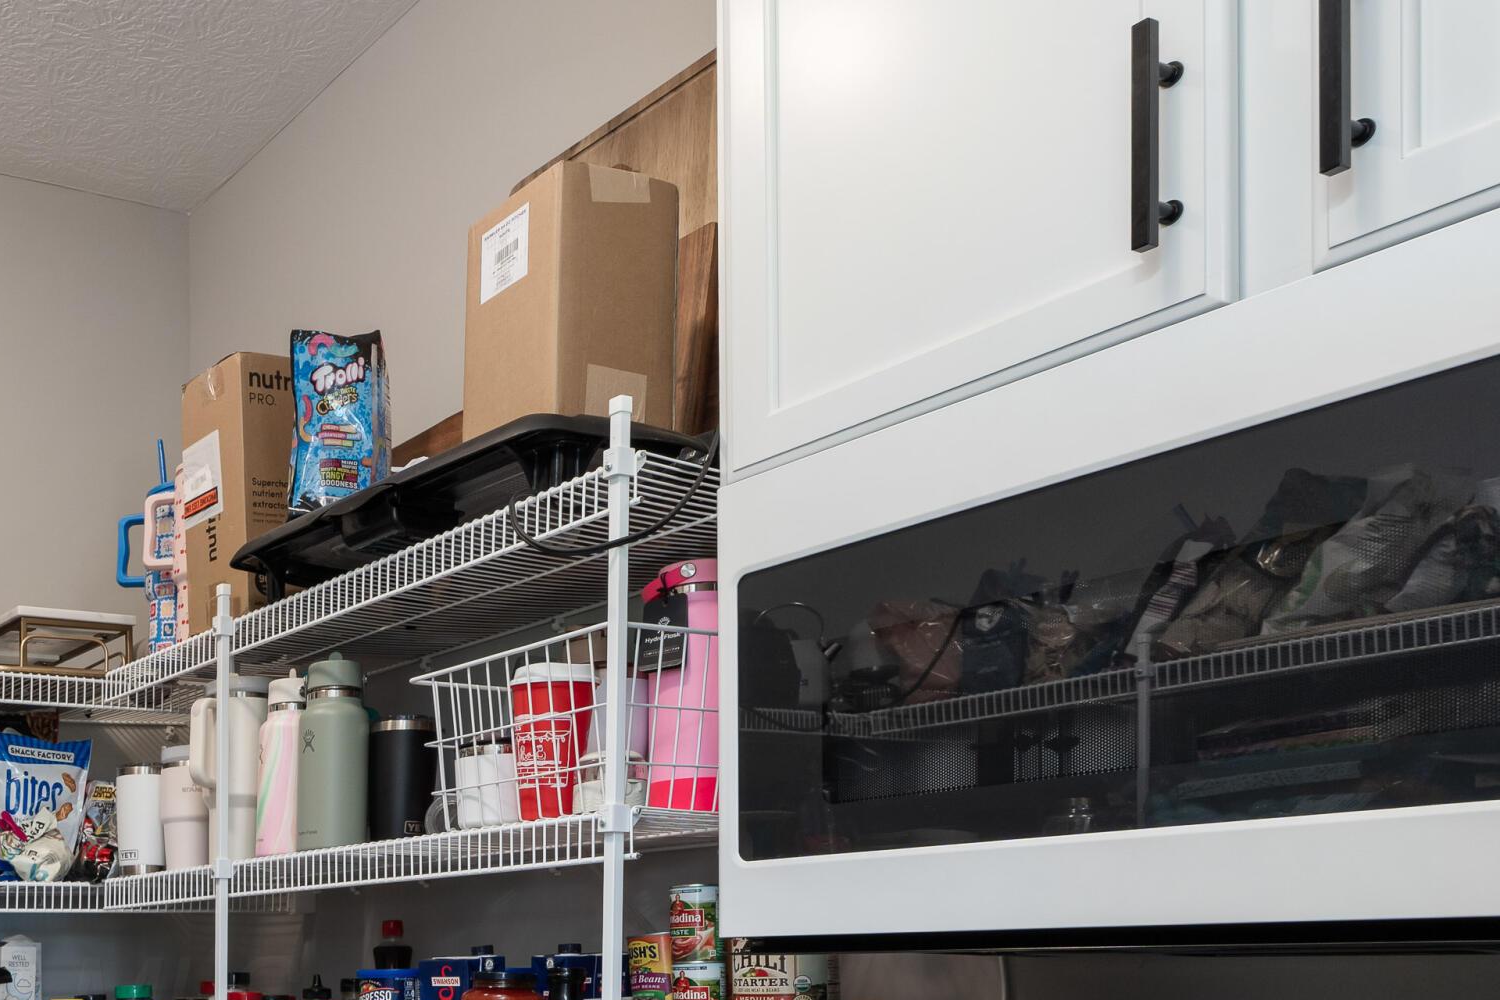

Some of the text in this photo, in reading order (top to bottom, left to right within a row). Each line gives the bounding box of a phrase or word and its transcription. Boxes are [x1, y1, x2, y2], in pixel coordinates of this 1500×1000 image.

[311, 356, 365, 393] Trolli
[249, 370, 291, 391] nutr
[320, 471, 345, 480] TANGY
[252, 477, 288, 492] Supercha
[252, 488, 283, 499] nutrient
[208, 515, 217, 561] nutr
[663, 632, 681, 641] Flask
[9, 747, 36, 758] SNACK
[5, 769, 63, 816] bites
[120, 851, 137, 859] YETI
[629, 945, 657, 959] USH'S
[8, 960, 30, 968] RESTED
[733, 948, 788, 974] CHILI
[638, 974, 667, 984] Beans
[733, 978, 789, 987] STARTER
